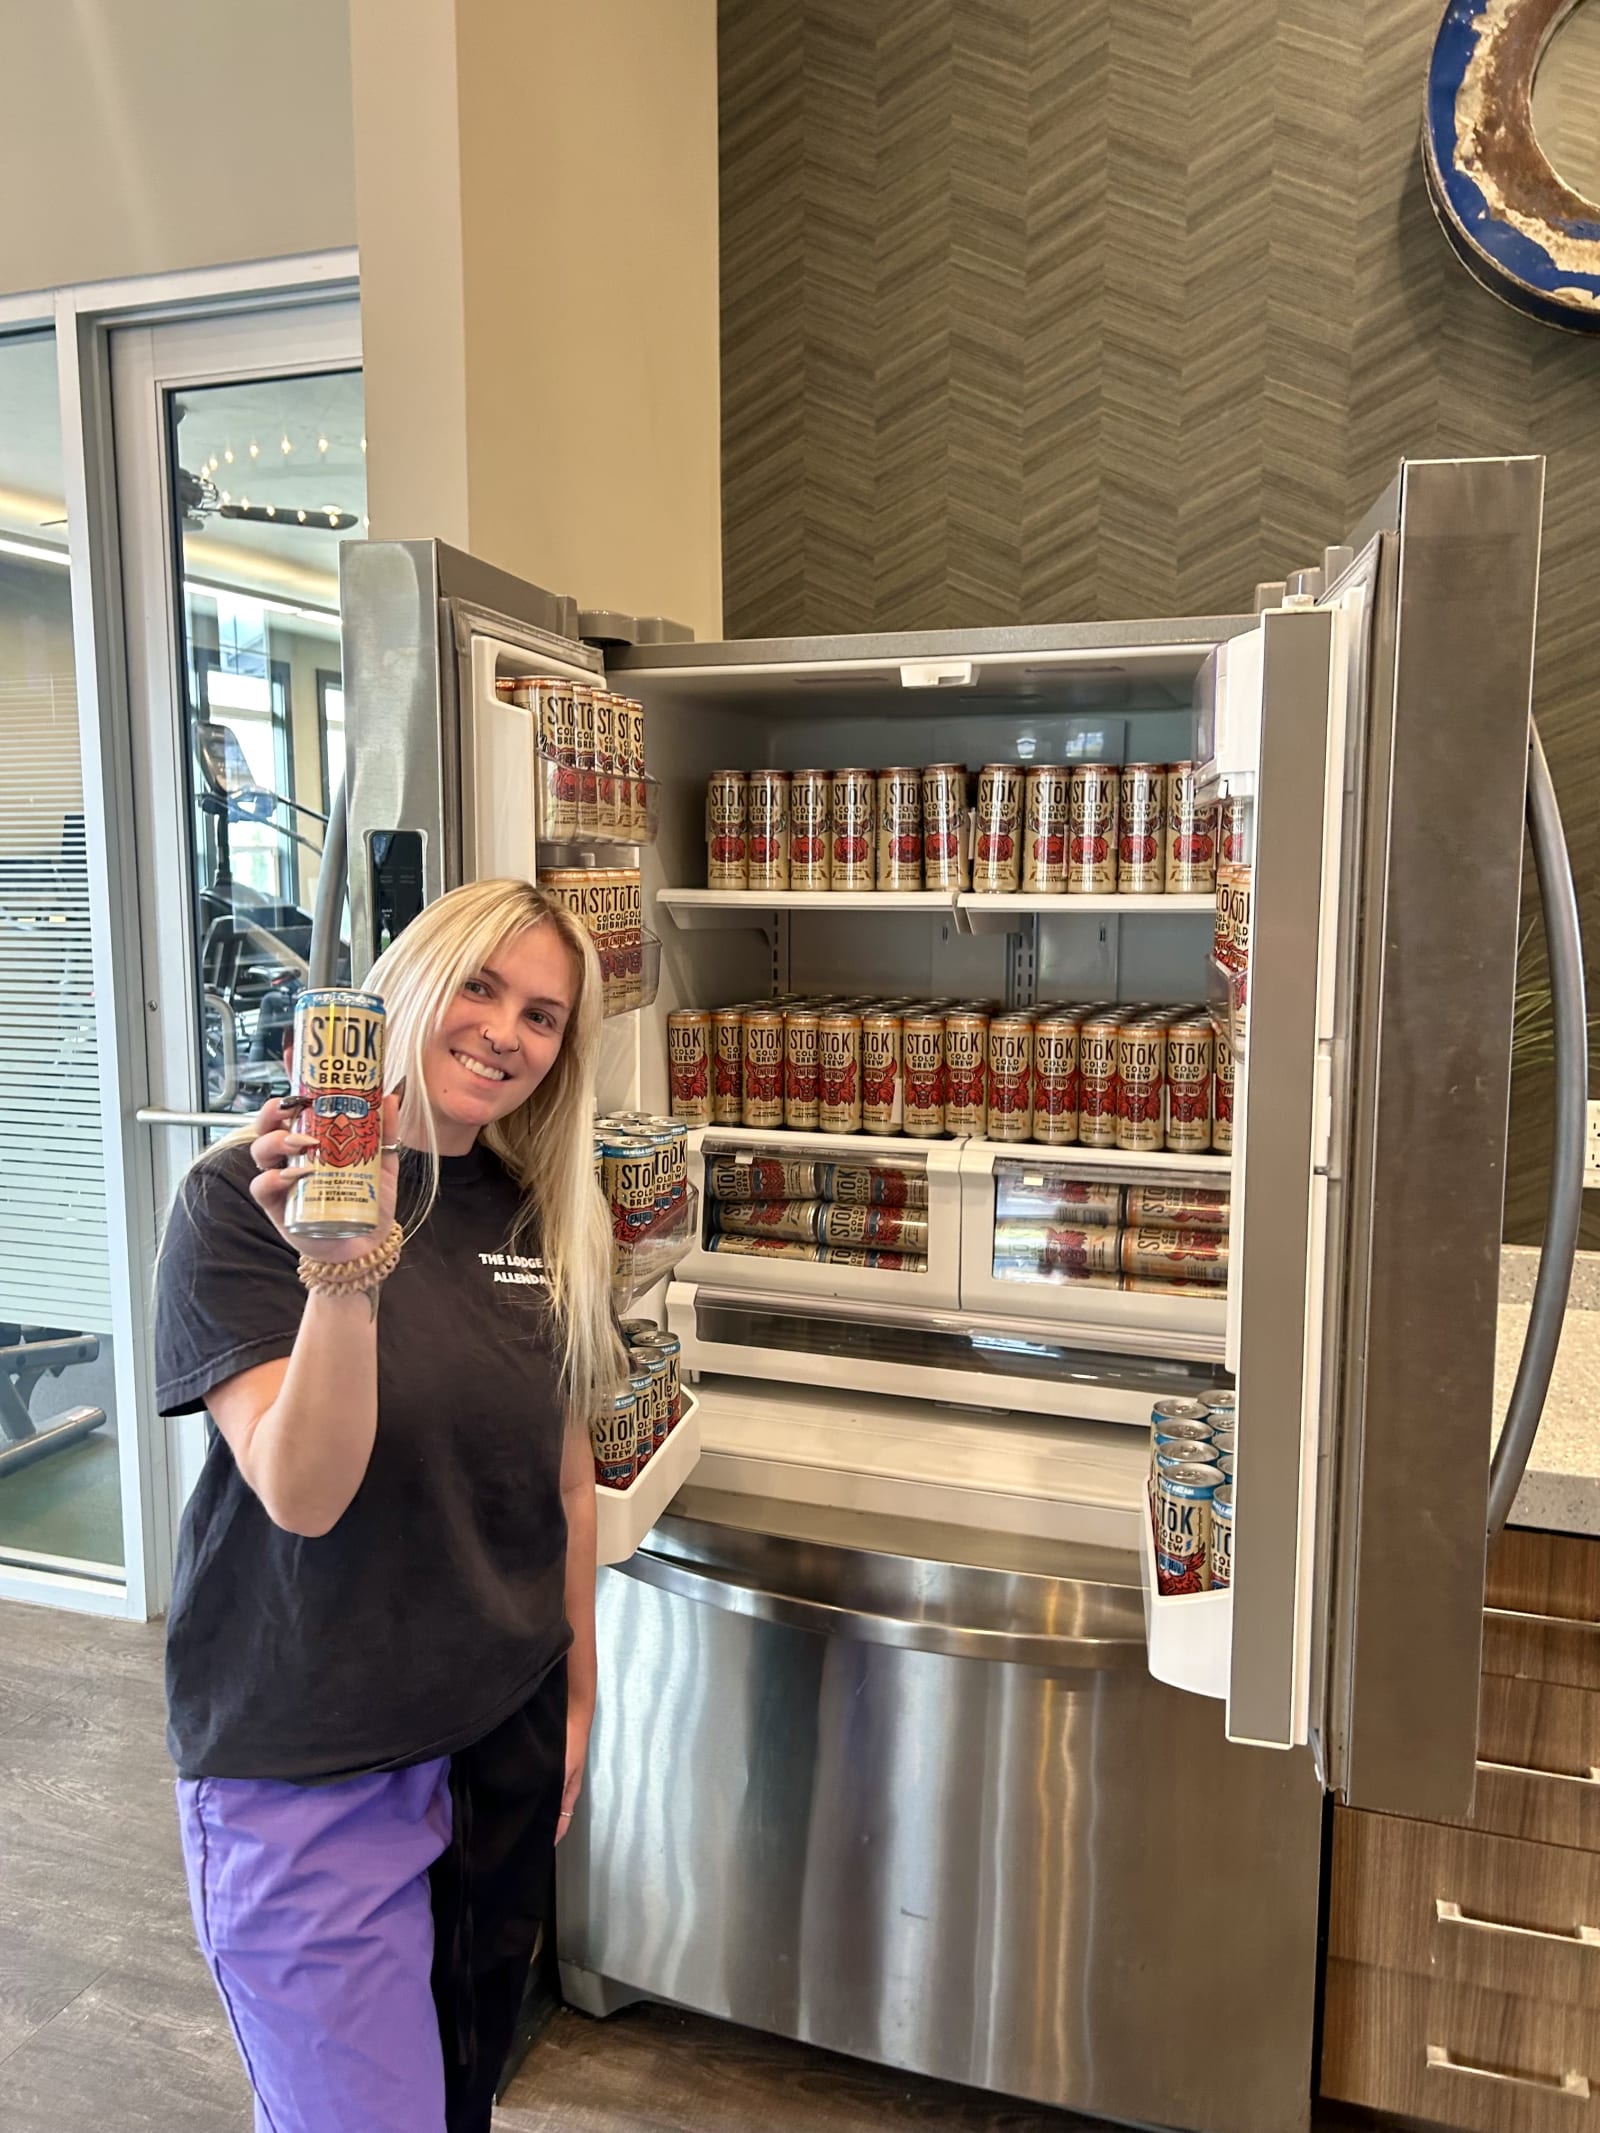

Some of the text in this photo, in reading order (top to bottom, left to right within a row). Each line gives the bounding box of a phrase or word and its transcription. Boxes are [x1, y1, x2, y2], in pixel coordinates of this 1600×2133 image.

[548, 697, 573, 725] STō
[598, 708, 611, 734] ST
[619, 713, 628, 739] ST
[712, 785, 746, 806] STōK
[835, 784, 867, 806] STōK
[923, 779, 956, 802] STōK
[981, 780, 1017, 802] STōK
[1073, 781, 1109, 802] STōK
[1122, 780, 1156, 802] STōK
[927, 809, 950, 817] BREW
[1126, 810, 1150, 818] BREW
[309, 1016, 379, 1061] STōK
[671, 1027, 700, 1047] STōK
[751, 1030, 782, 1049] STōK
[820, 1032, 849, 1052] STōK
[908, 1033, 941, 1054] STōK
[947, 1031, 979, 1052] STōK
[992, 1036, 1025, 1057] STōK
[1039, 1037, 1073, 1058] STōK
[1081, 1039, 1115, 1060] STōK
[1121, 1042, 1156, 1065] STōK
[1169, 1042, 1206, 1064] STōK
[1219, 1043, 1233, 1065] ST
[320, 1059, 367, 1072] COLD
[319, 1073, 367, 1084] BREW
[318, 1096, 364, 1112] ENERGY
[655, 1150, 672, 1175] Tō
[622, 1163, 655, 1190] STō
[657, 1175, 672, 1183] OLD
[478, 1253, 544, 1268] THE LODGE
[636, 1393, 652, 1421] Tō
[604, 1440, 631, 1451] COLD
[604, 1448, 632, 1460] BREW
